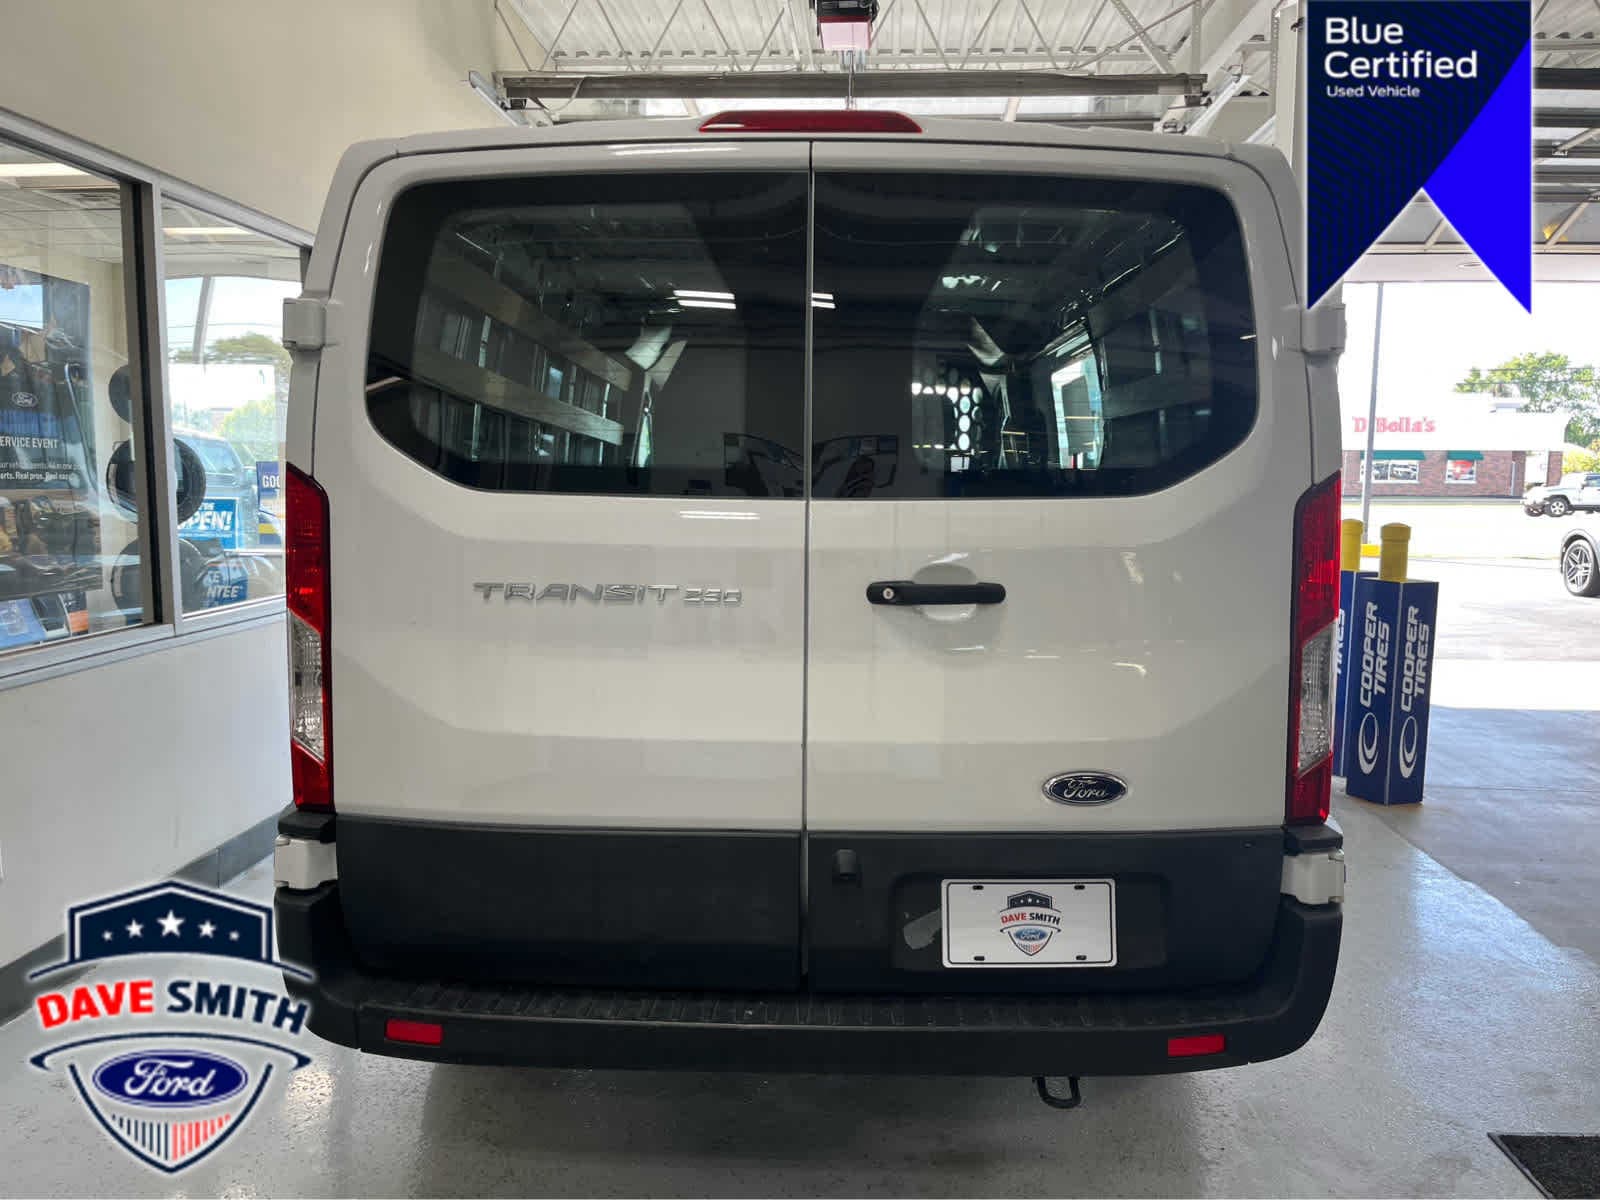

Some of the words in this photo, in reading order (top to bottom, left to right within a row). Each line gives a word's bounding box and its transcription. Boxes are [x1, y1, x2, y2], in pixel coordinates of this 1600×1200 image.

[1352, 416, 1436, 432] DBella's
[0, 435, 31, 448] ERVICE
[32, 438, 58, 449] EVENT
[178, 510, 233, 532] PEN!
[473, 581, 679, 602] TRANSIT
[1359, 601, 1379, 708] COOPER
[1373, 618, 1391, 695] TIRES
[1401, 605, 1420, 712] COOPER
[1414, 622, 1430, 698] TIRES
[1063, 778, 1109, 798] Ford
[1001, 913, 1027, 925] DAVE
[1029, 912, 1060, 925] SMITH
